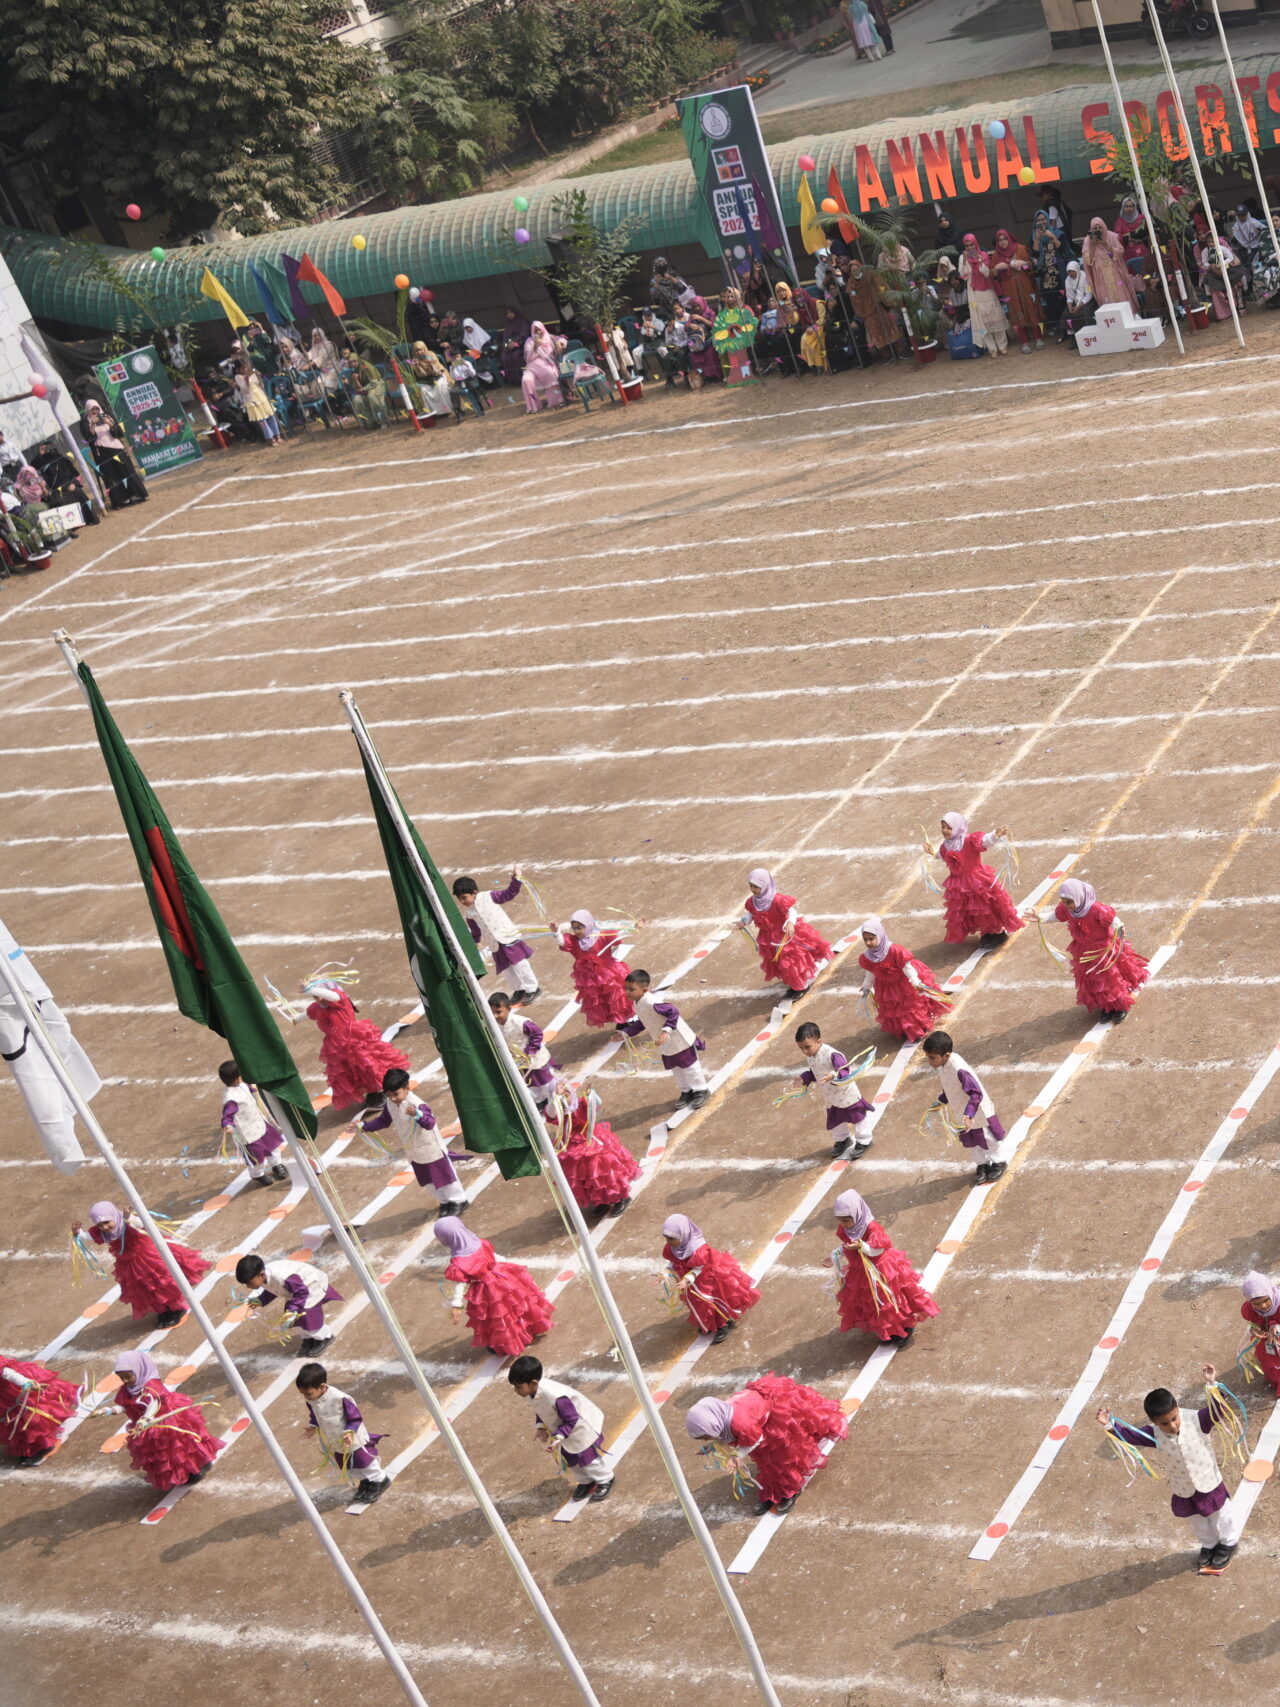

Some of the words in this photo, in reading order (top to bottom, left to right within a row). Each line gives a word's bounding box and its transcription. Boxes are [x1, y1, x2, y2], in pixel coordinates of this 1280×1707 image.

[855, 116, 1060, 213] ANNUAL
[722, 214, 761, 233] 202-2
[1104, 317, 1115, 328] 1st
[1083, 336, 1097, 347] 3rd
[1132, 330, 1147, 342] 2nd
[126, 384, 156, 399] ANNUAL
[128, 391, 159, 406] SPORTS
[141, 448, 171, 466] MANARAT
[170, 441, 194, 456] DAKA
